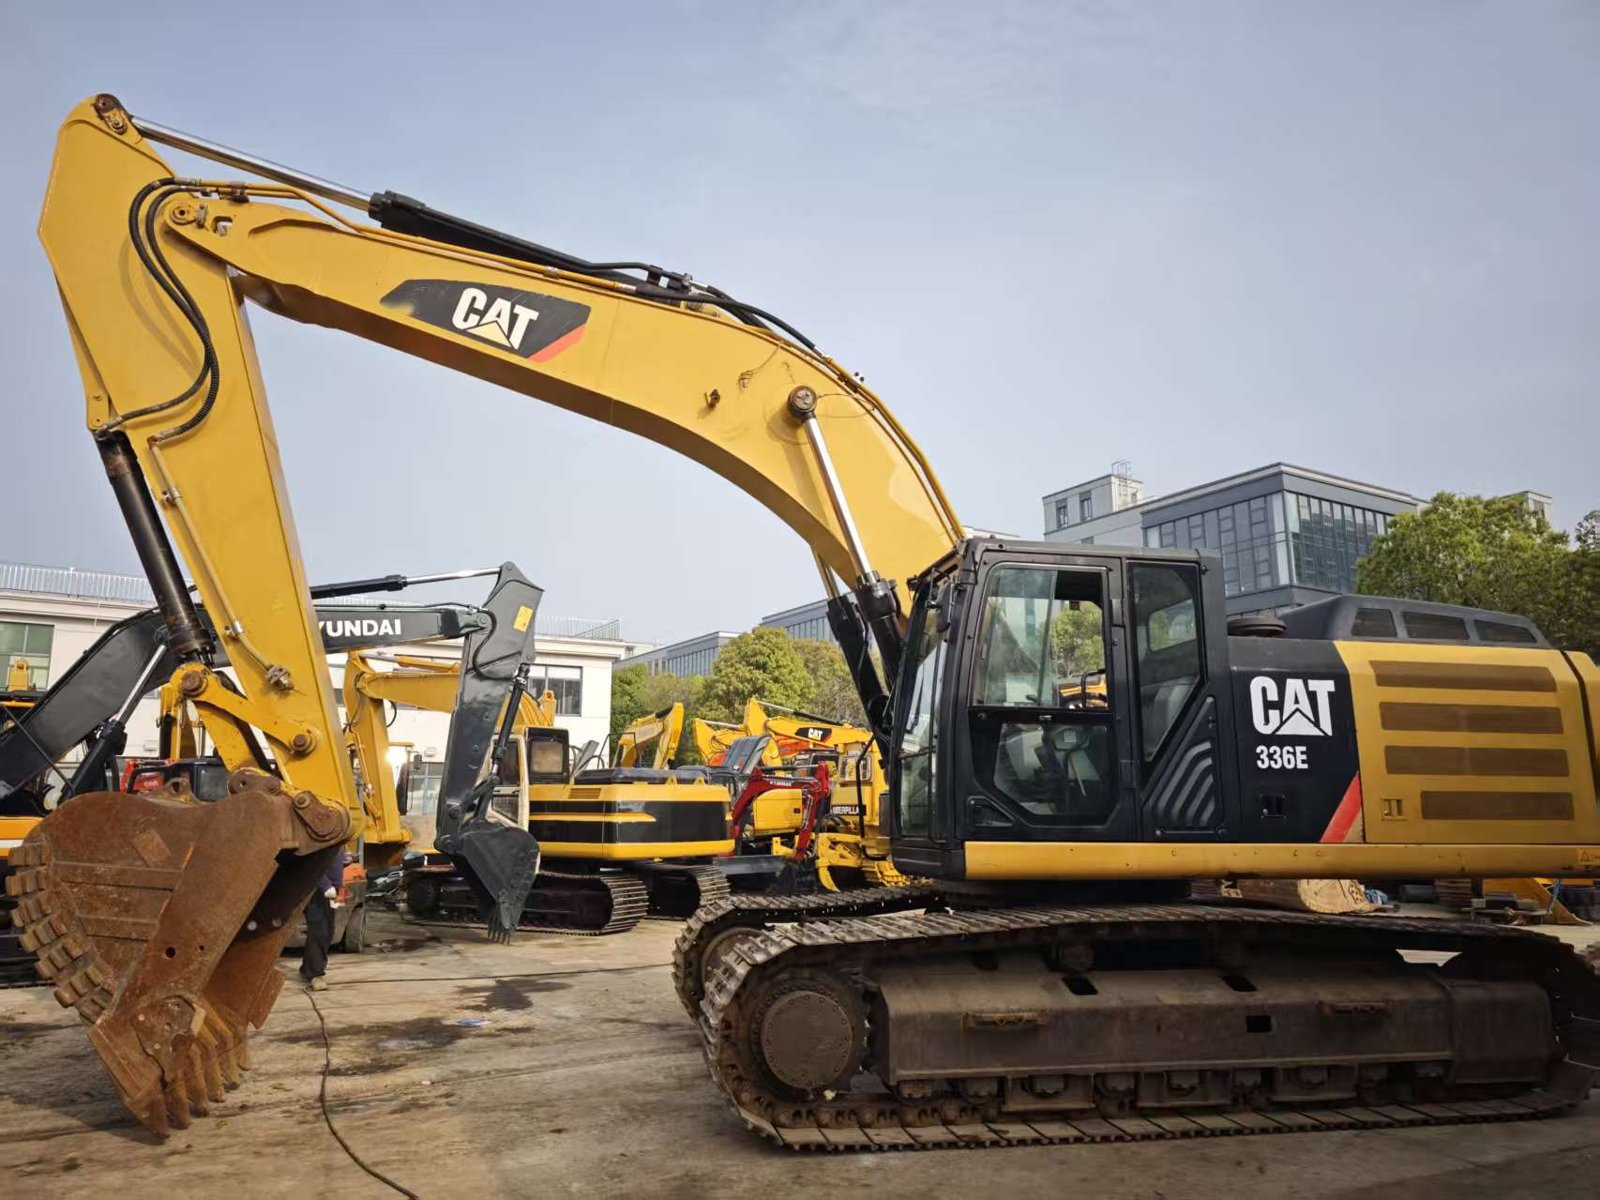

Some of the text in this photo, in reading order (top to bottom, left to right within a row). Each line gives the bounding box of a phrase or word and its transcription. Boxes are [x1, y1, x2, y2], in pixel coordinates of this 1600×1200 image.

[452, 287, 540, 350] CAT
[1249, 675, 1336, 736] CAT
[808, 728, 823, 740] CAT
[1255, 745, 1309, 770] 336E
